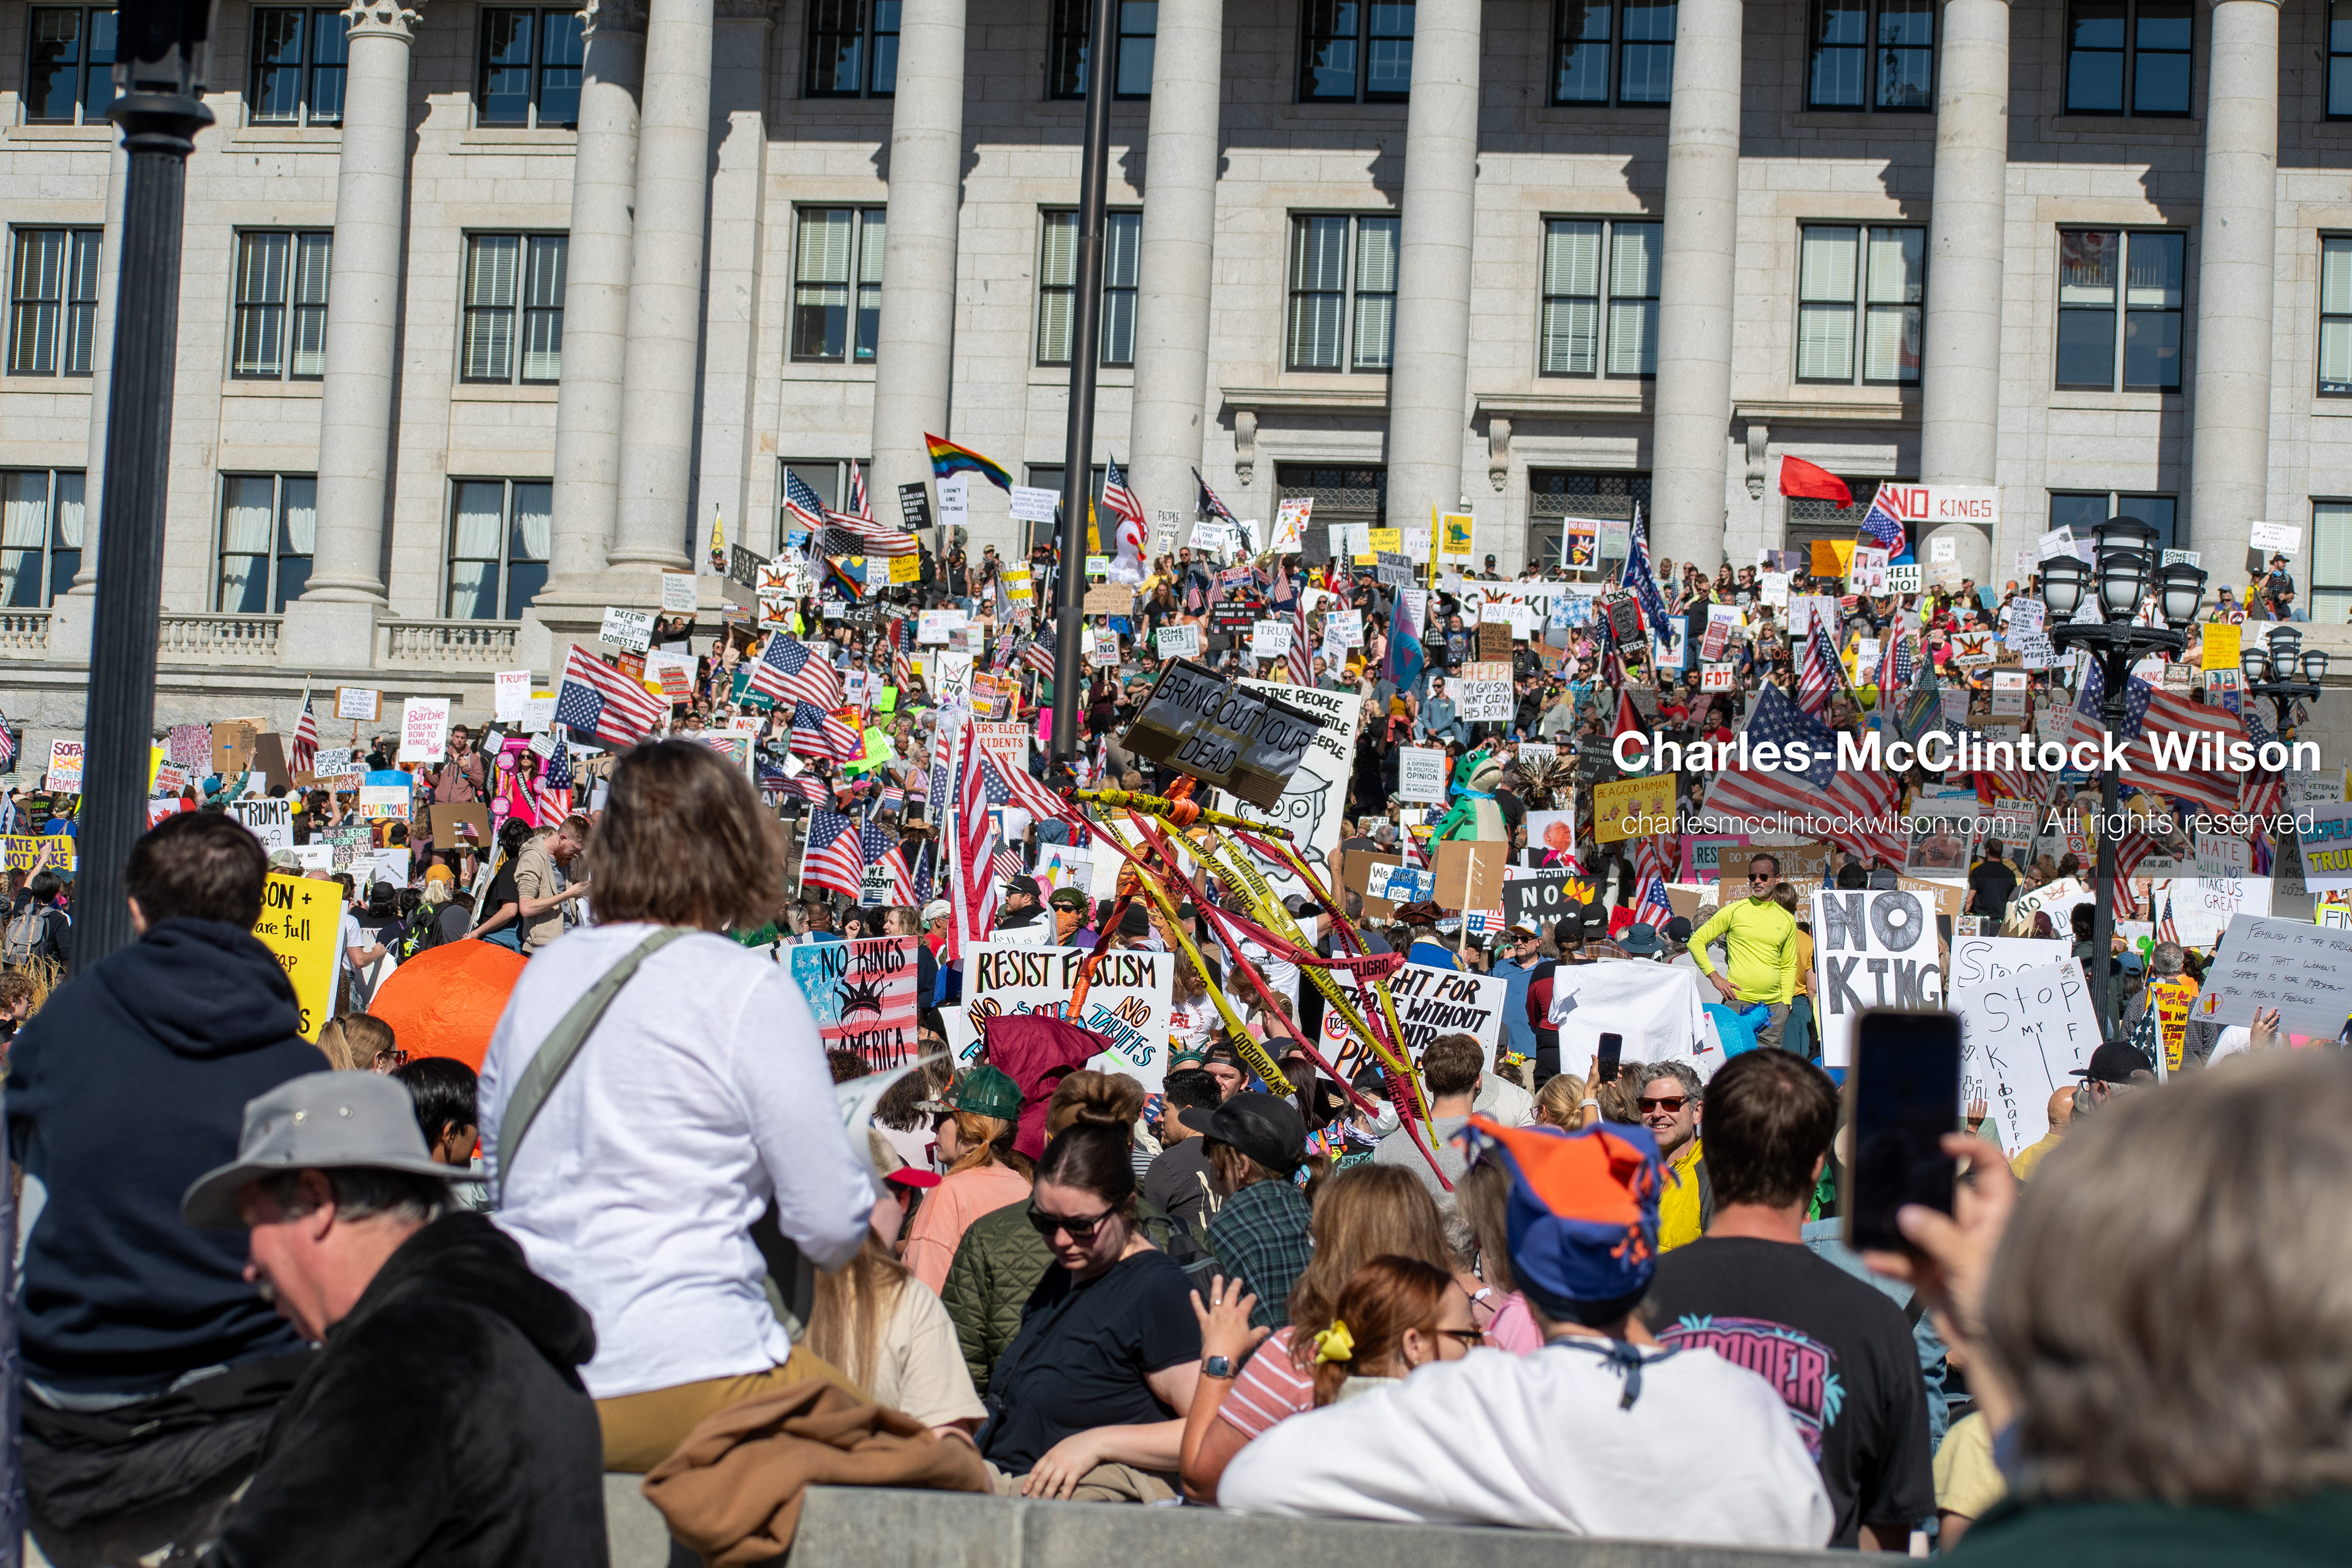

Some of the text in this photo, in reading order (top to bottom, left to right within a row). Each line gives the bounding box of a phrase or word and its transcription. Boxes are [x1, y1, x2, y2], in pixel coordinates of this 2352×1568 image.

[902, 492, 925, 500] EXERCISING
[1891, 488, 1991, 518] NO KINGS
[1158, 510, 1179, 522] PEOPLE
[1226, 568, 1245, 576] STOP
[1379, 567, 1412, 586] TRUMP
[1885, 565, 1918, 579] HELL
[1888, 579, 1917, 592] NO!
[1606, 590, 1632, 603] DICK
[615, 610, 646, 622] DEFEND
[1486, 606, 1523, 619] ANTIFA
[1714, 614, 1735, 624] DUMP
[603, 620, 652, 638] CONSTITUTION
[603, 633, 644, 649] DOMESTIC
[1274, 638, 1286, 647] IS
[1621, 641, 1645, 653] TATER
[1099, 644, 1114, 652] NO
[628, 657, 638, 666] ONE
[2040, 657, 2063, 665] FOR?
[625, 665, 636, 674] FREE
[1464, 665, 1512, 681] HELP!
[497, 673, 529, 684] TRUMP
[1705, 672, 1731, 685] FDT
[971, 690, 993, 700] FELON
[1464, 682, 1510, 695] MY GAY SON
[1295, 689, 1344, 714] PEOPLE
[1486, 694, 1510, 704] CLEAN
[408, 709, 445, 722] Barbie
[1155, 674, 1311, 760] BRING OUT YOUR
[1464, 705, 1509, 719] HIS ROOM
[999, 724, 1026, 734] ELECT
[316, 750, 350, 760] IMMIGRANTS
[1177, 736, 1238, 775] DEAD
[1589, 756, 1611, 766] RIGHTS
[172, 761, 190, 771] CAN'T
[317, 764, 348, 777] GREAT
[52, 770, 80, 778] OVER
[156, 774, 185, 785] AMERICA
[1406, 772, 1440, 782] OPINION.
[1618, 784, 1639, 795] GOOD
[362, 804, 407, 817] EVERYONE
[1996, 800, 2008, 809] ALL
[233, 800, 289, 826] TRUMP
[323, 829, 344, 839] THIS IS
[2012, 831, 2029, 840] SIGN
[331, 837, 354, 846] HISTORY
[352, 843, 373, 853] SCHOOL
[2201, 837, 2239, 861] HATE
[334, 855, 350, 864] KIDS
[2157, 859, 2172, 869] JOKE
[868, 867, 884, 877] WE
[1372, 865, 1417, 884] We DON'T
[2197, 859, 2244, 880] WILL NOT
[860, 878, 894, 889] DISSENT
[1370, 883, 1411, 901] We need
[2281, 884, 2305, 897] 2025
[1521, 887, 1559, 908] NO
[2204, 894, 2241, 913] GREAT
[256, 915, 309, 941] are full
[1822, 892, 1923, 952] NO
[821, 938, 907, 982] NO KINGS
[2236, 951, 2295, 967] IDEA THAT
[976, 952, 1055, 994] RESIST
[2283, 974, 2299, 984] MORE
[1433, 973, 1481, 1005] FOR
[2223, 987, 2242, 995] THAN
[1116, 995, 1152, 1028] NO
[1403, 997, 1491, 1033] WITHOUT
[1169, 1014, 1190, 1028] PSL
[1327, 1016, 1348, 1030] ICE
[1087, 1002, 1156, 1067] TARIFFS
